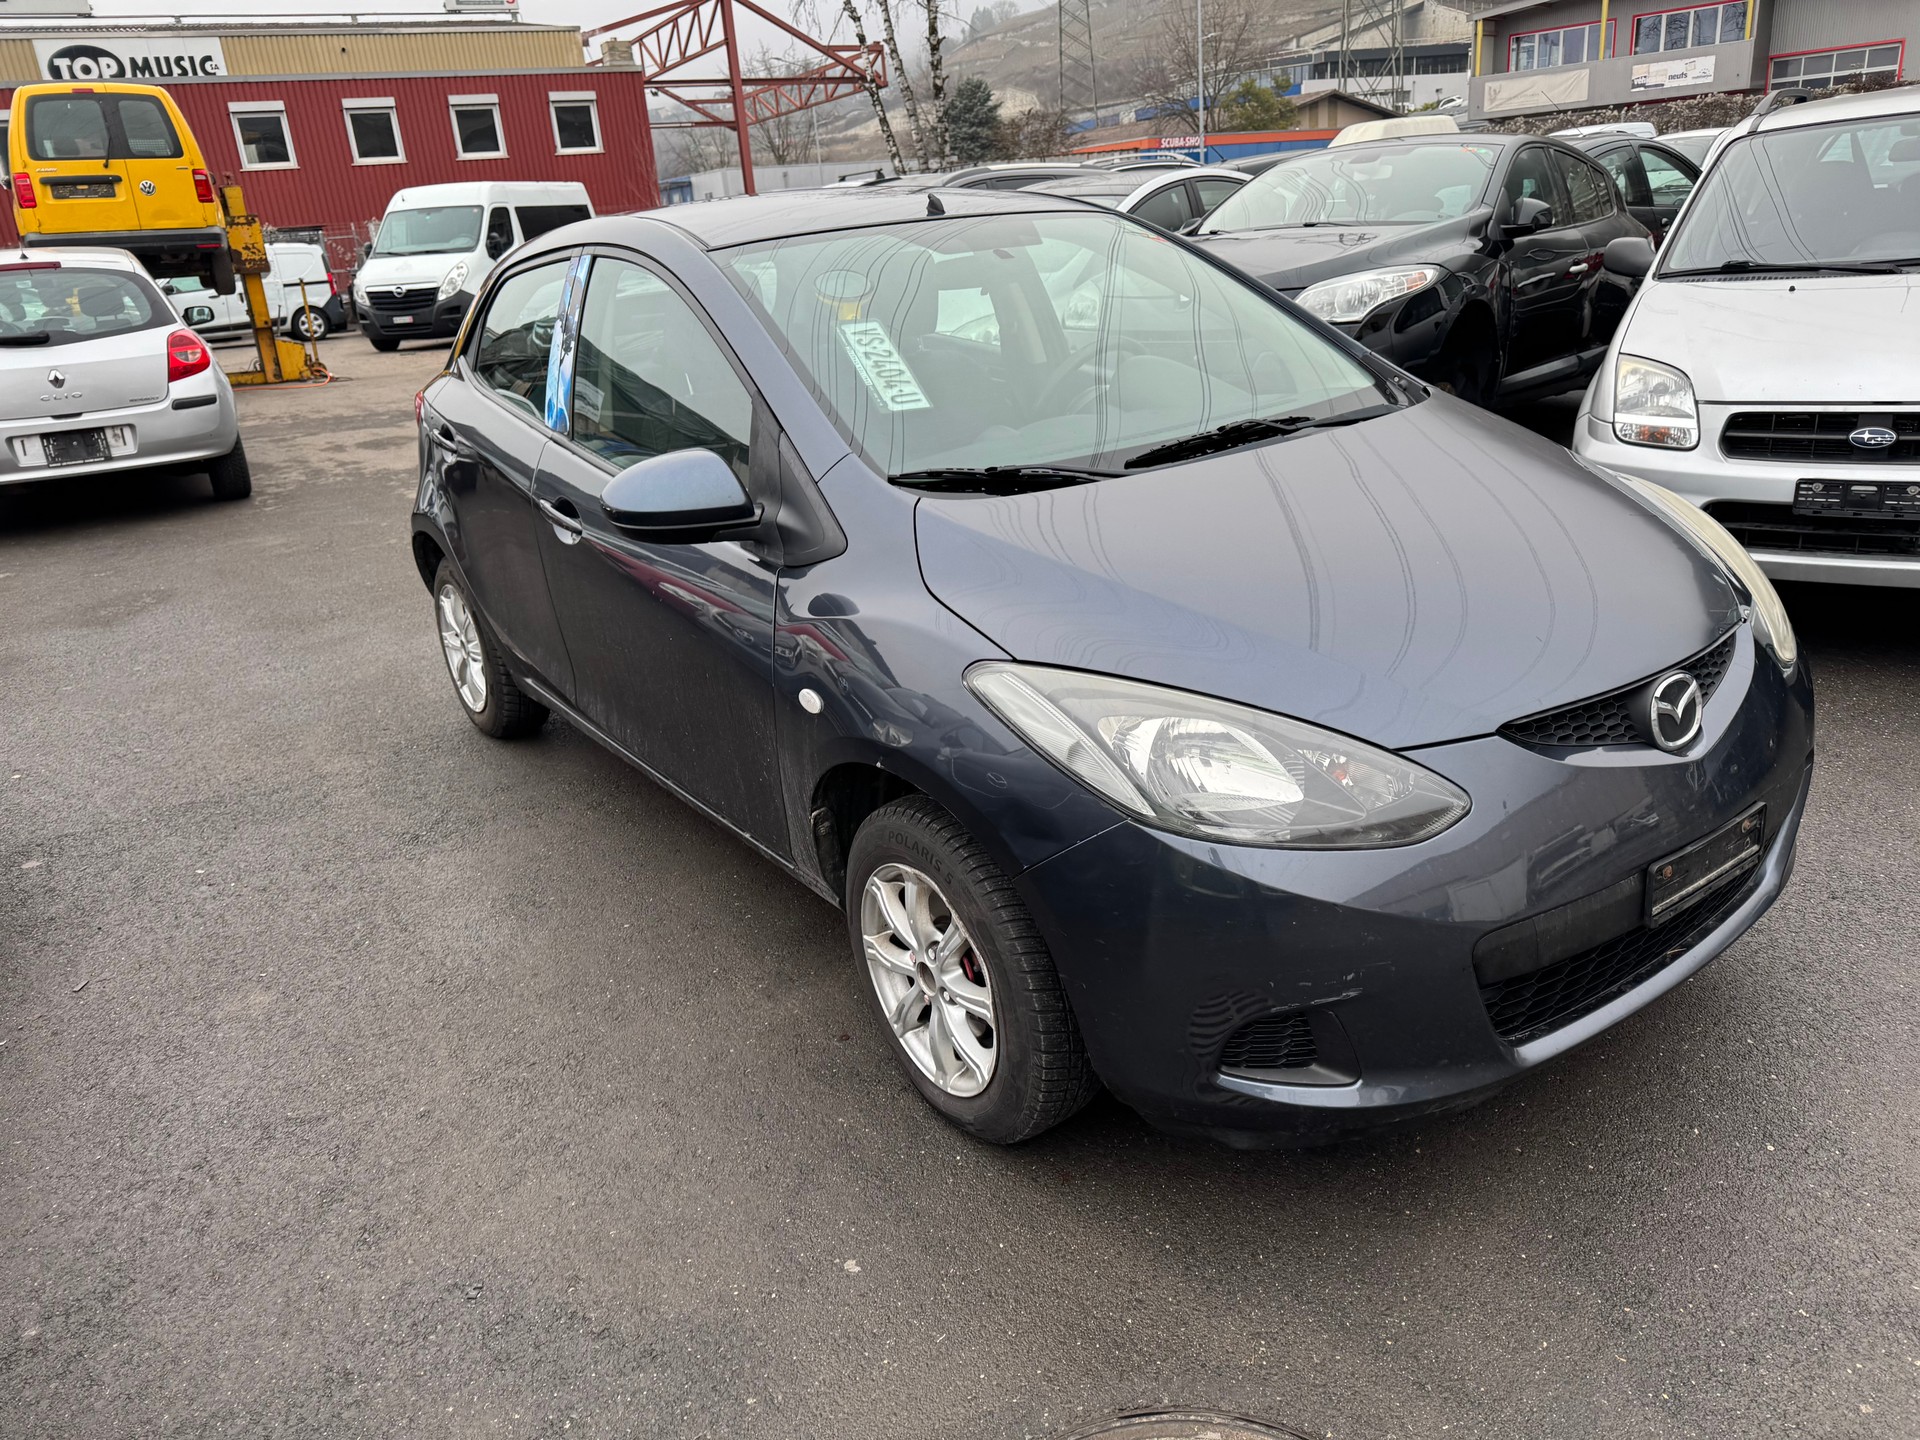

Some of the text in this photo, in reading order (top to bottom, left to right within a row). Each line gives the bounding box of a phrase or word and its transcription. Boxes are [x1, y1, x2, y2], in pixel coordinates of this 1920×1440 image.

[53, 55, 220, 80] TOP MUSIC SA
[1667, 71, 1688, 81] neufs
[1161, 136, 1204, 148] SCUBA-SHO
[40, 392, 82, 401] CLIO
[888, 830, 943, 873] POLARIS
